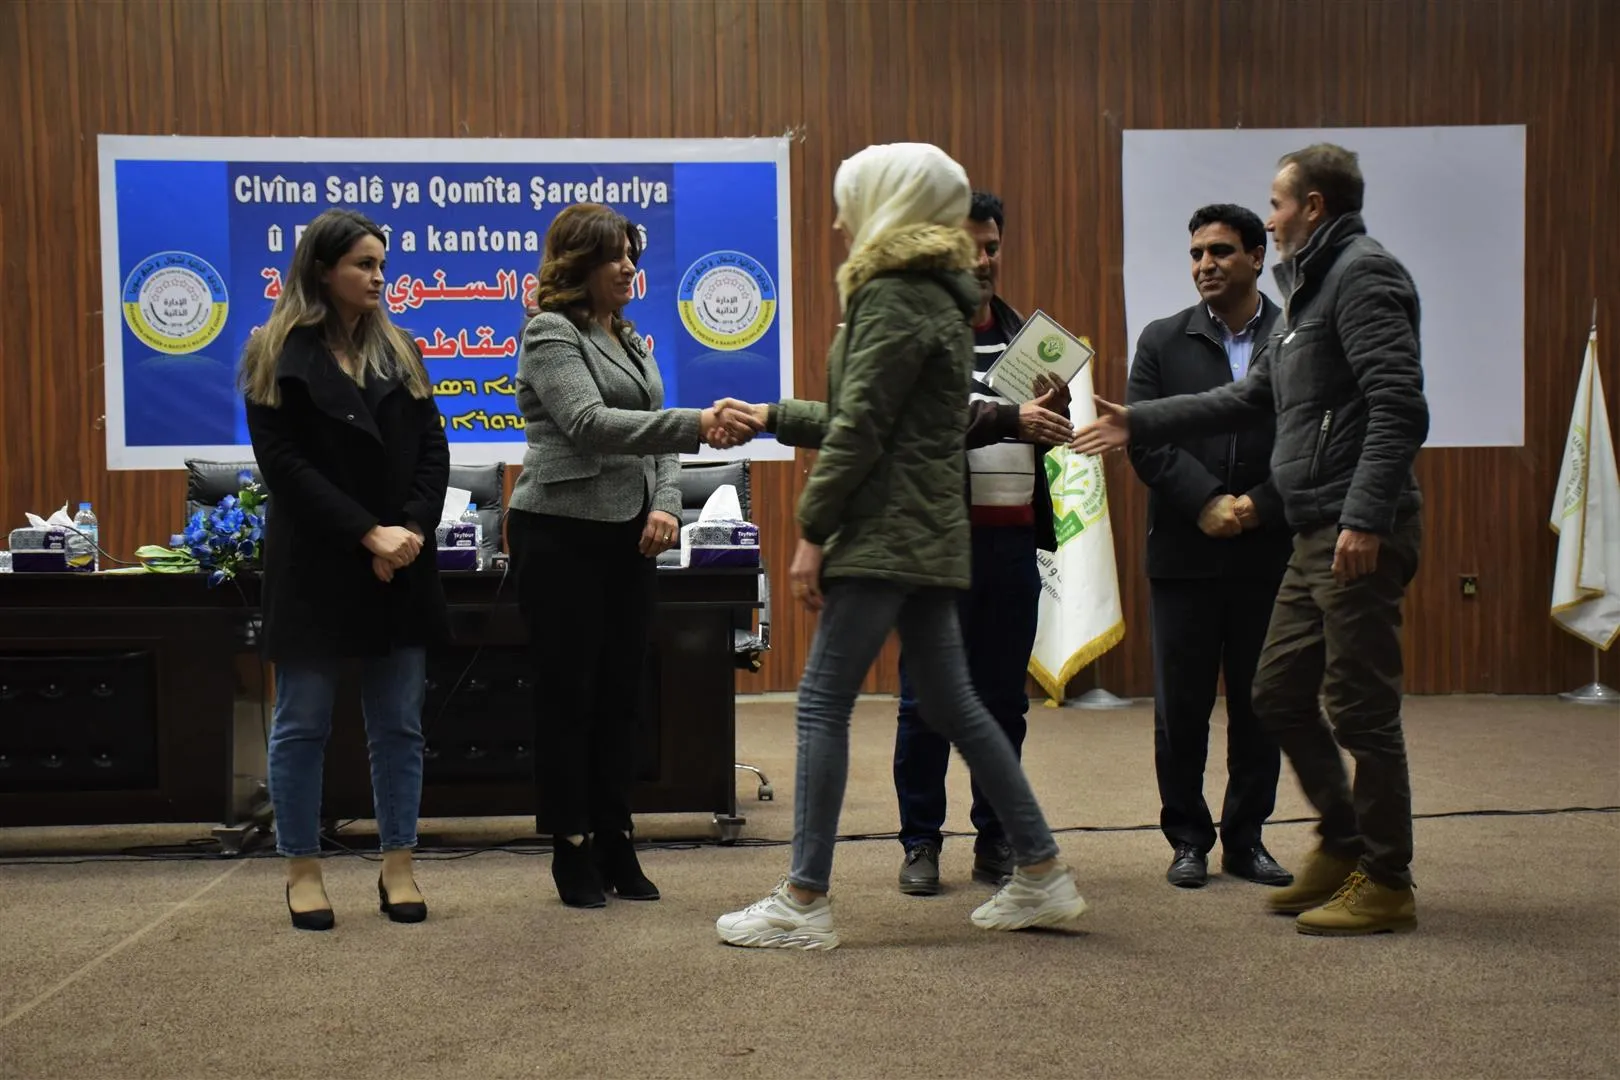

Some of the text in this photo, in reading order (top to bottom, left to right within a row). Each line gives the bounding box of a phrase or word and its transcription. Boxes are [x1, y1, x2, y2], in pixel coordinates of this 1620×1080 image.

[326, 175, 384, 204] Salê
[391, 181, 420, 209] ya
[429, 175, 521, 209] Qomîta
[268, 224, 283, 252] û
[401, 231, 416, 252] a
[427, 225, 539, 252] kantona
[385, 268, 517, 313] السنوي
[413, 326, 518, 359] مقاطع
